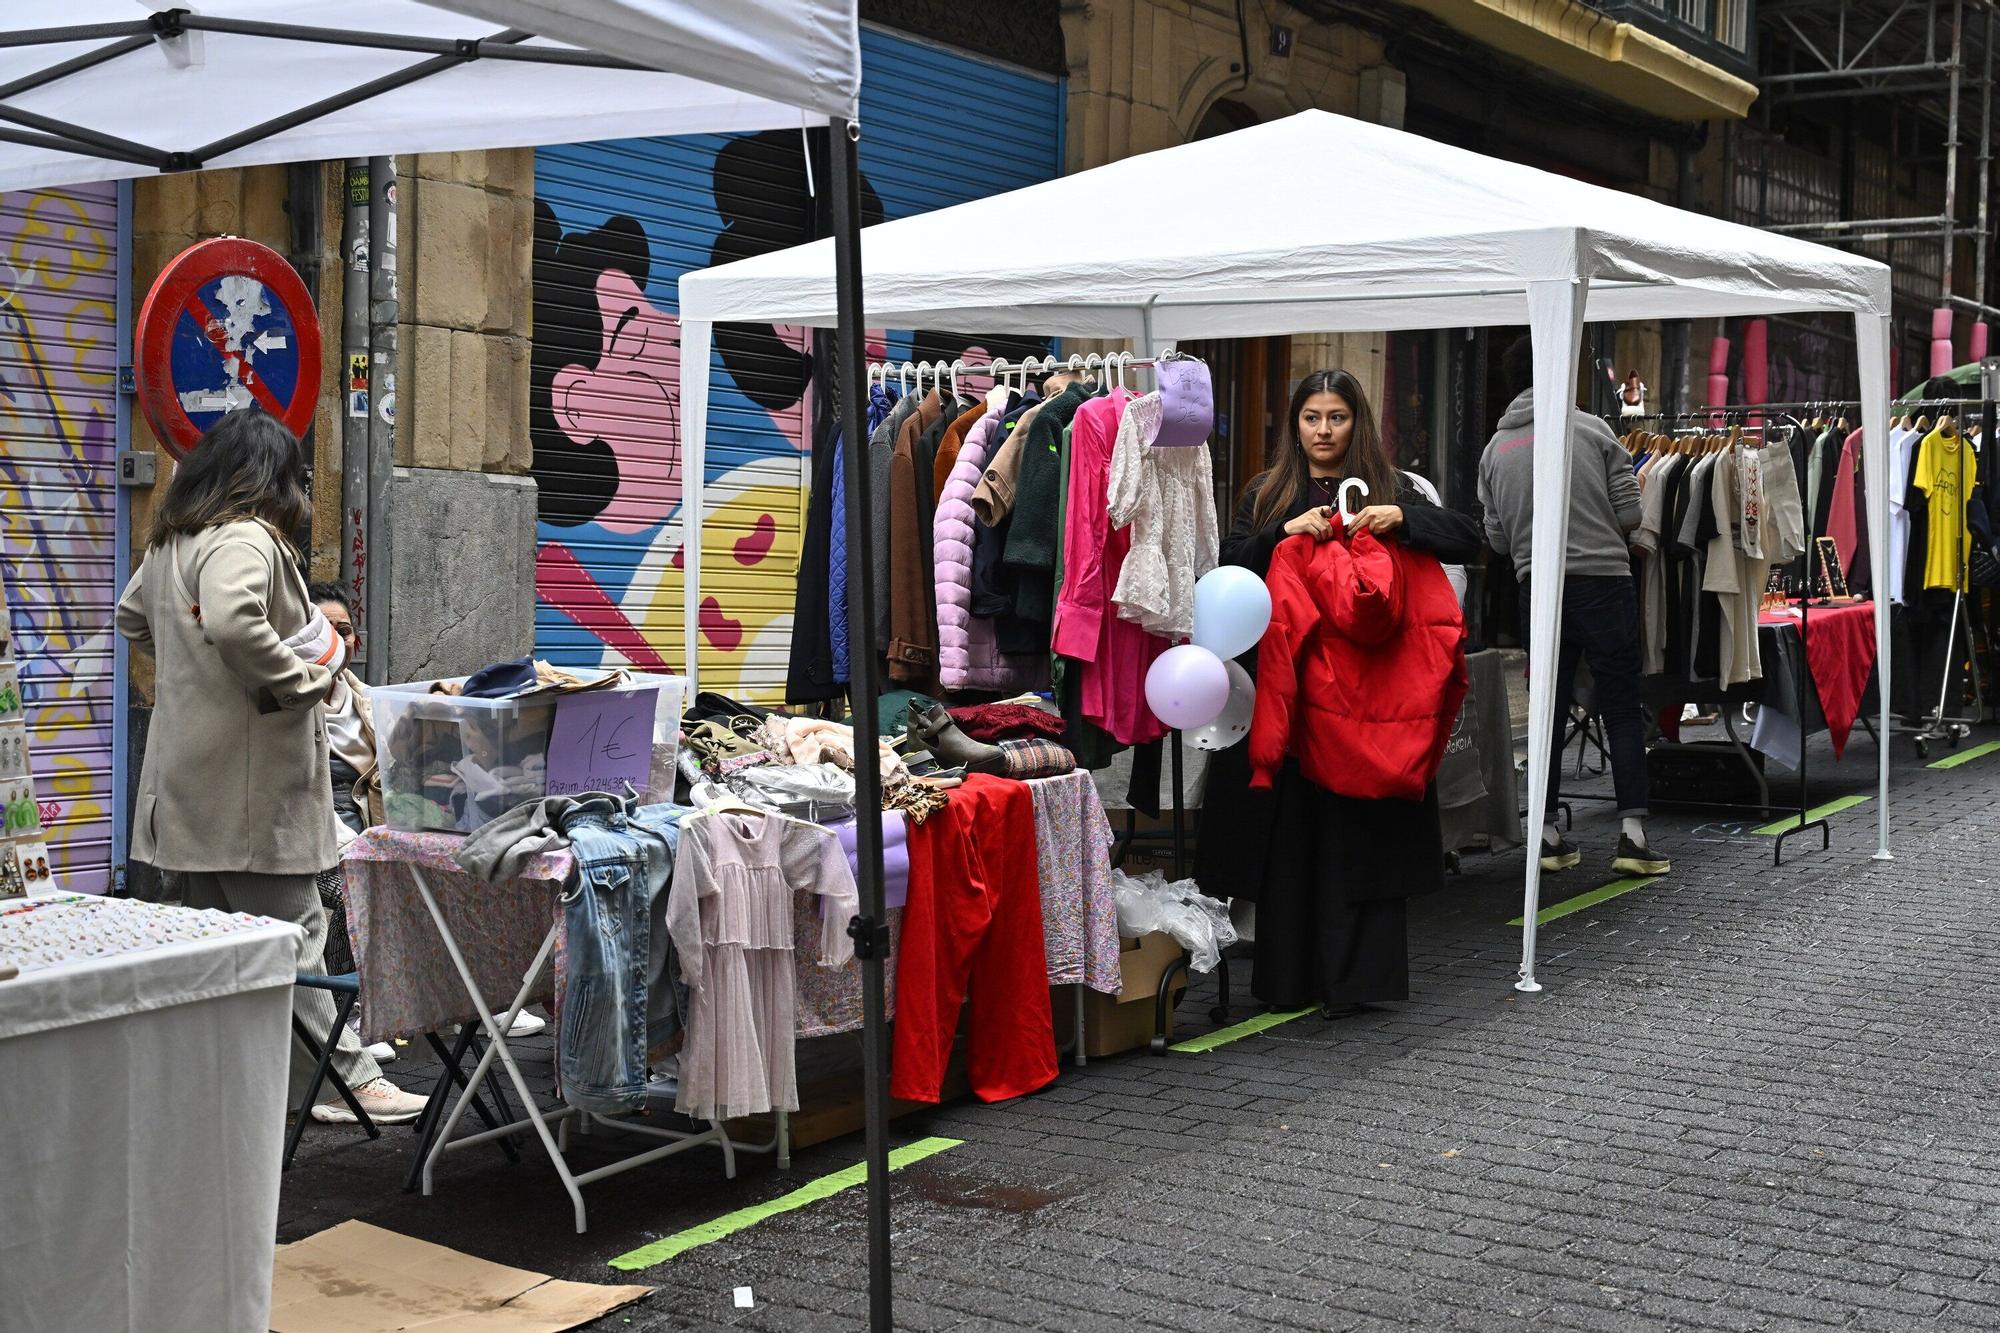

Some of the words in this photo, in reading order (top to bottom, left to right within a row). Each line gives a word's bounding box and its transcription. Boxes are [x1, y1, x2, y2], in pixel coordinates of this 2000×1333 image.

[1278, 31, 1287, 50] 9
[577, 713, 637, 773] 1€
[1443, 735, 1473, 754] ROKOIA
